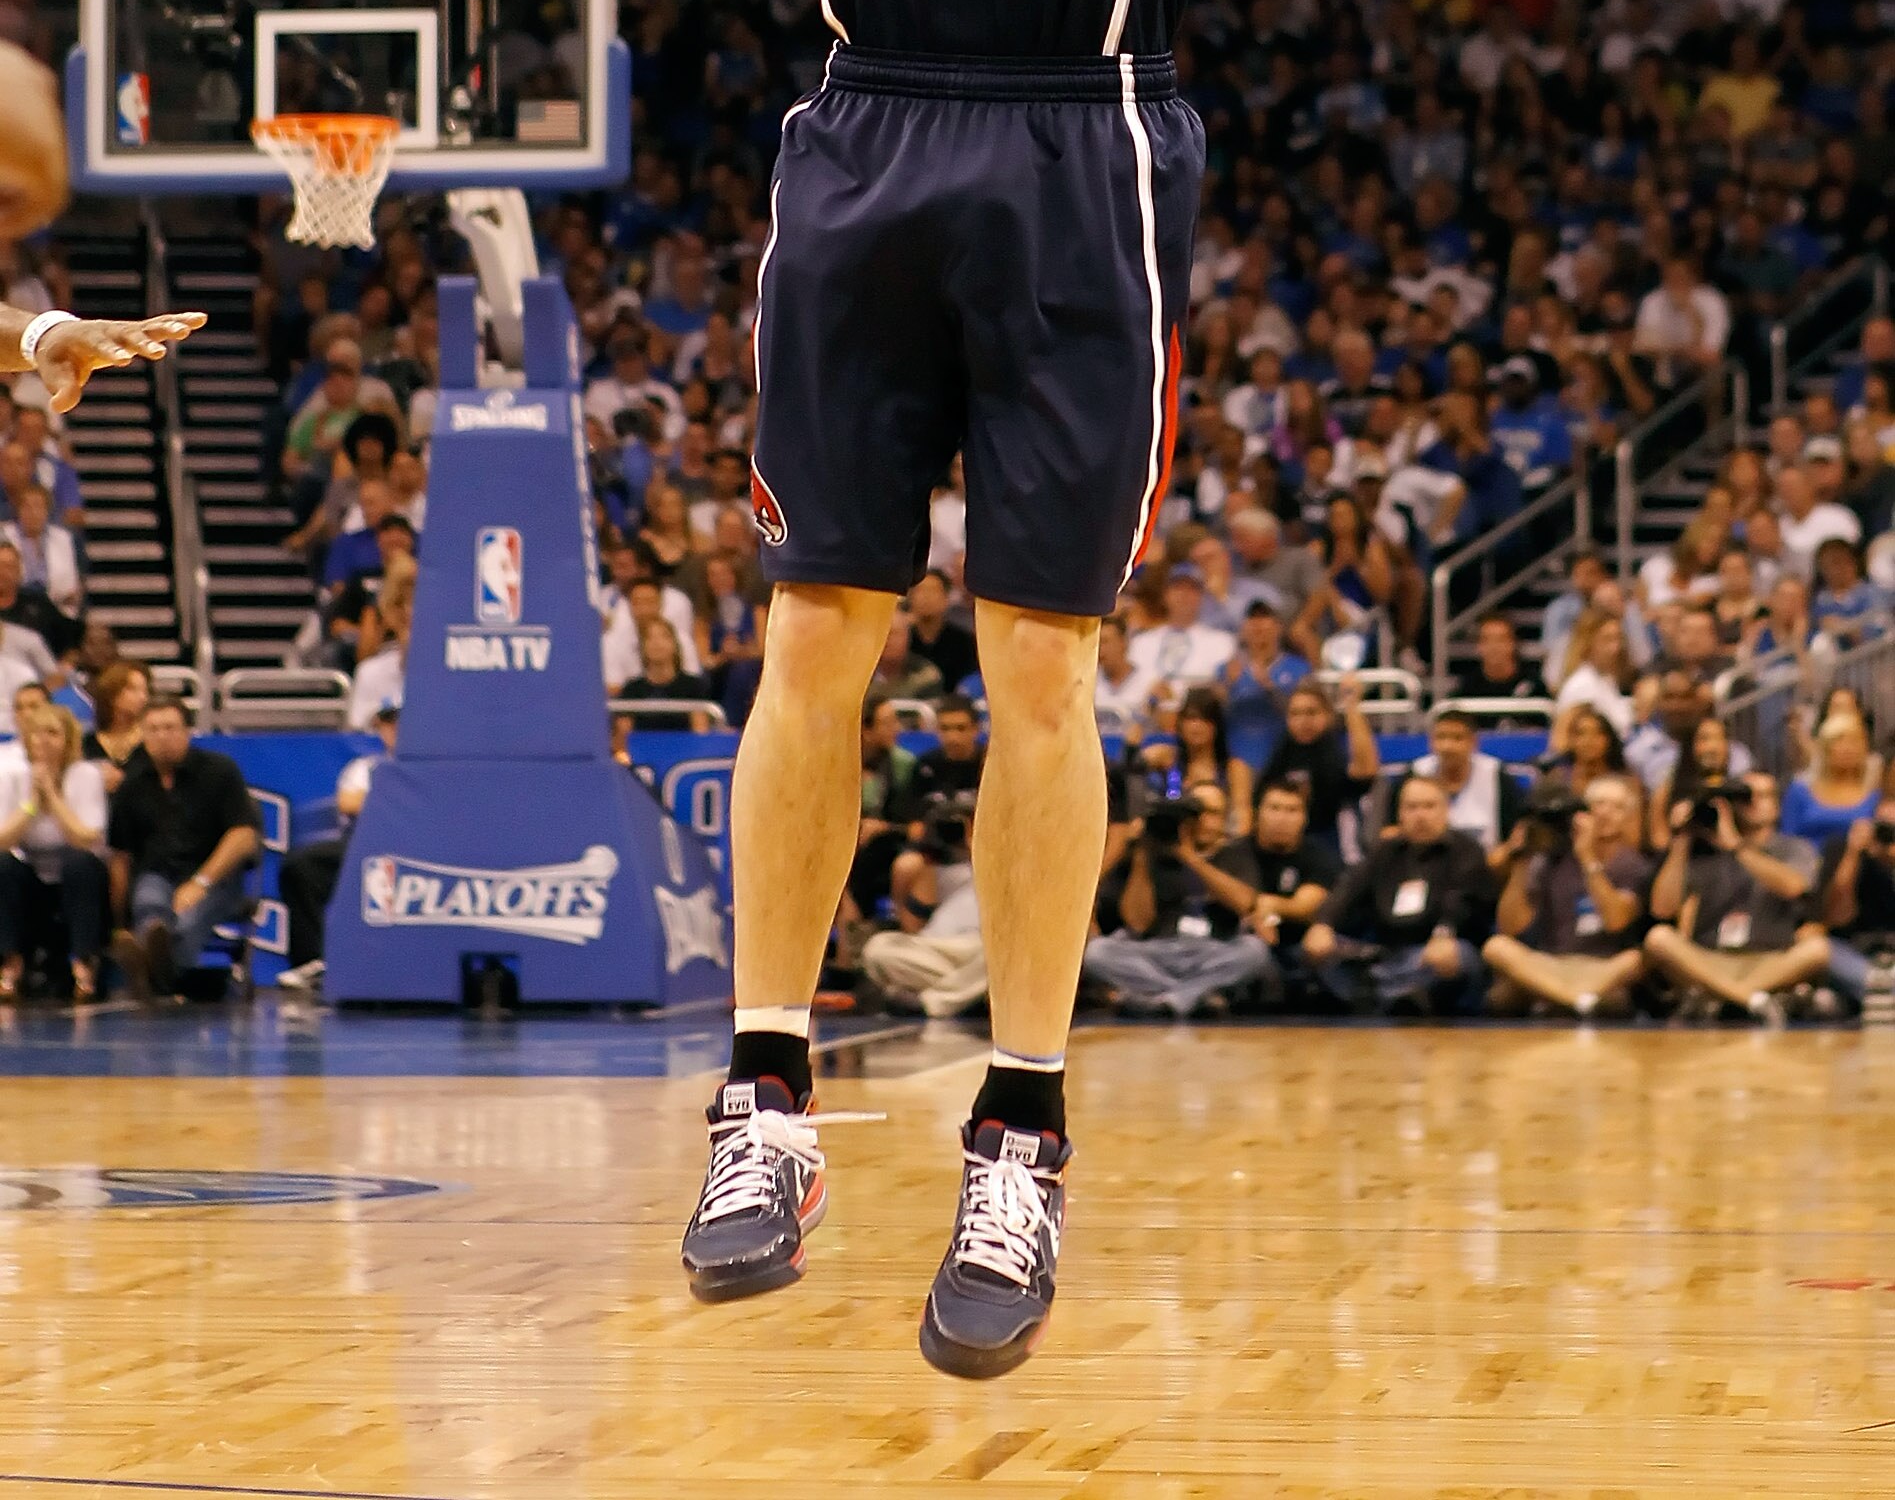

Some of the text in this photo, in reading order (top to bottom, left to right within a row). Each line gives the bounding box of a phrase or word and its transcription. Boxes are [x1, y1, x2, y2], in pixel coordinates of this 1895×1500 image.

[445, 636, 552, 671] NBA TV
[393, 873, 608, 918] PLAYOFFS
